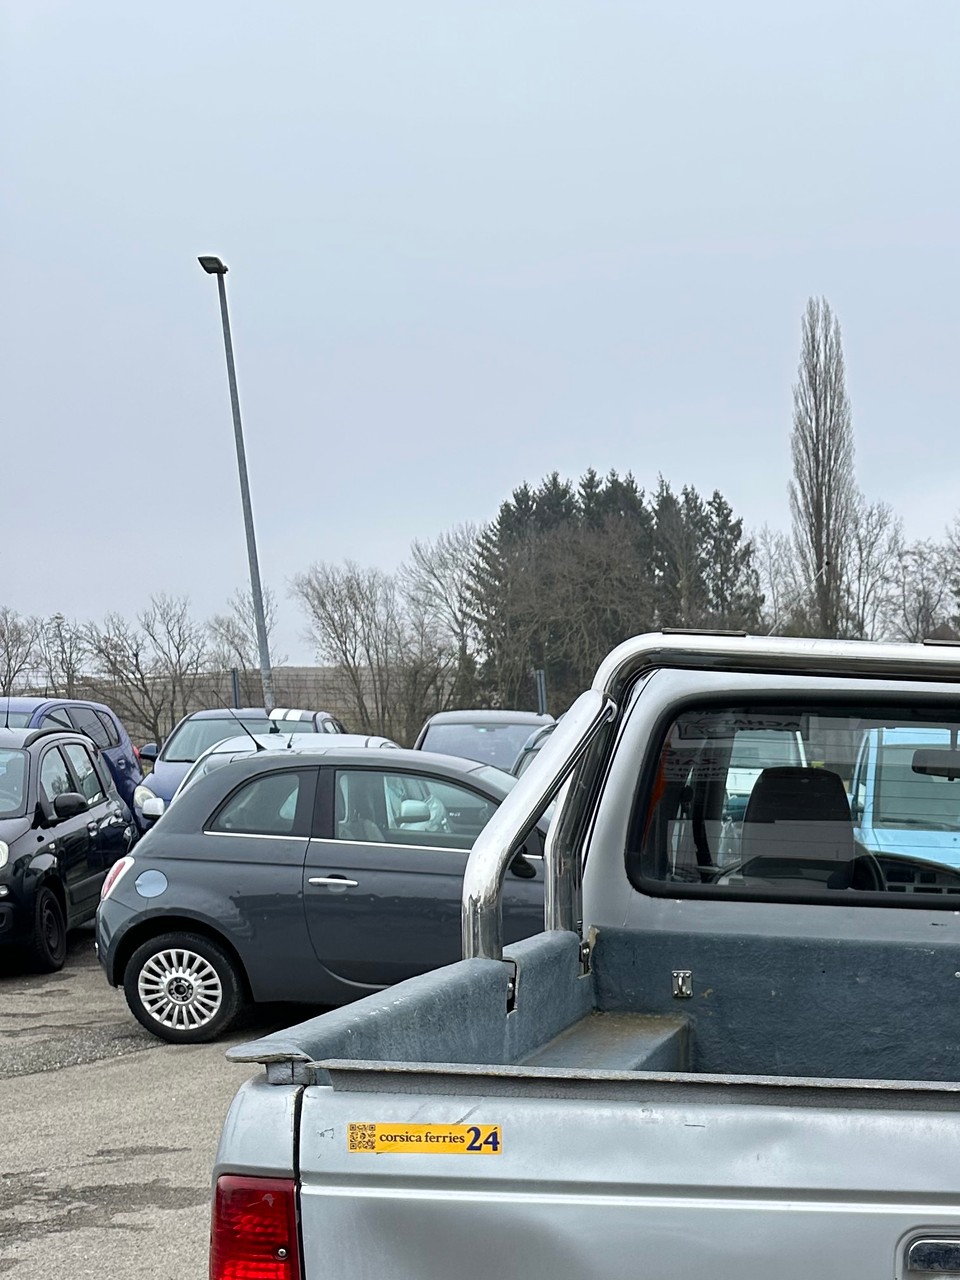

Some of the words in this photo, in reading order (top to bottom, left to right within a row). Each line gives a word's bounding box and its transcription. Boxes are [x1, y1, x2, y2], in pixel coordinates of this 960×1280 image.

[379, 1131, 423, 1143] corsica
[424, 1132, 465, 1144] ferries
[466, 1126, 500, 1152] 24
